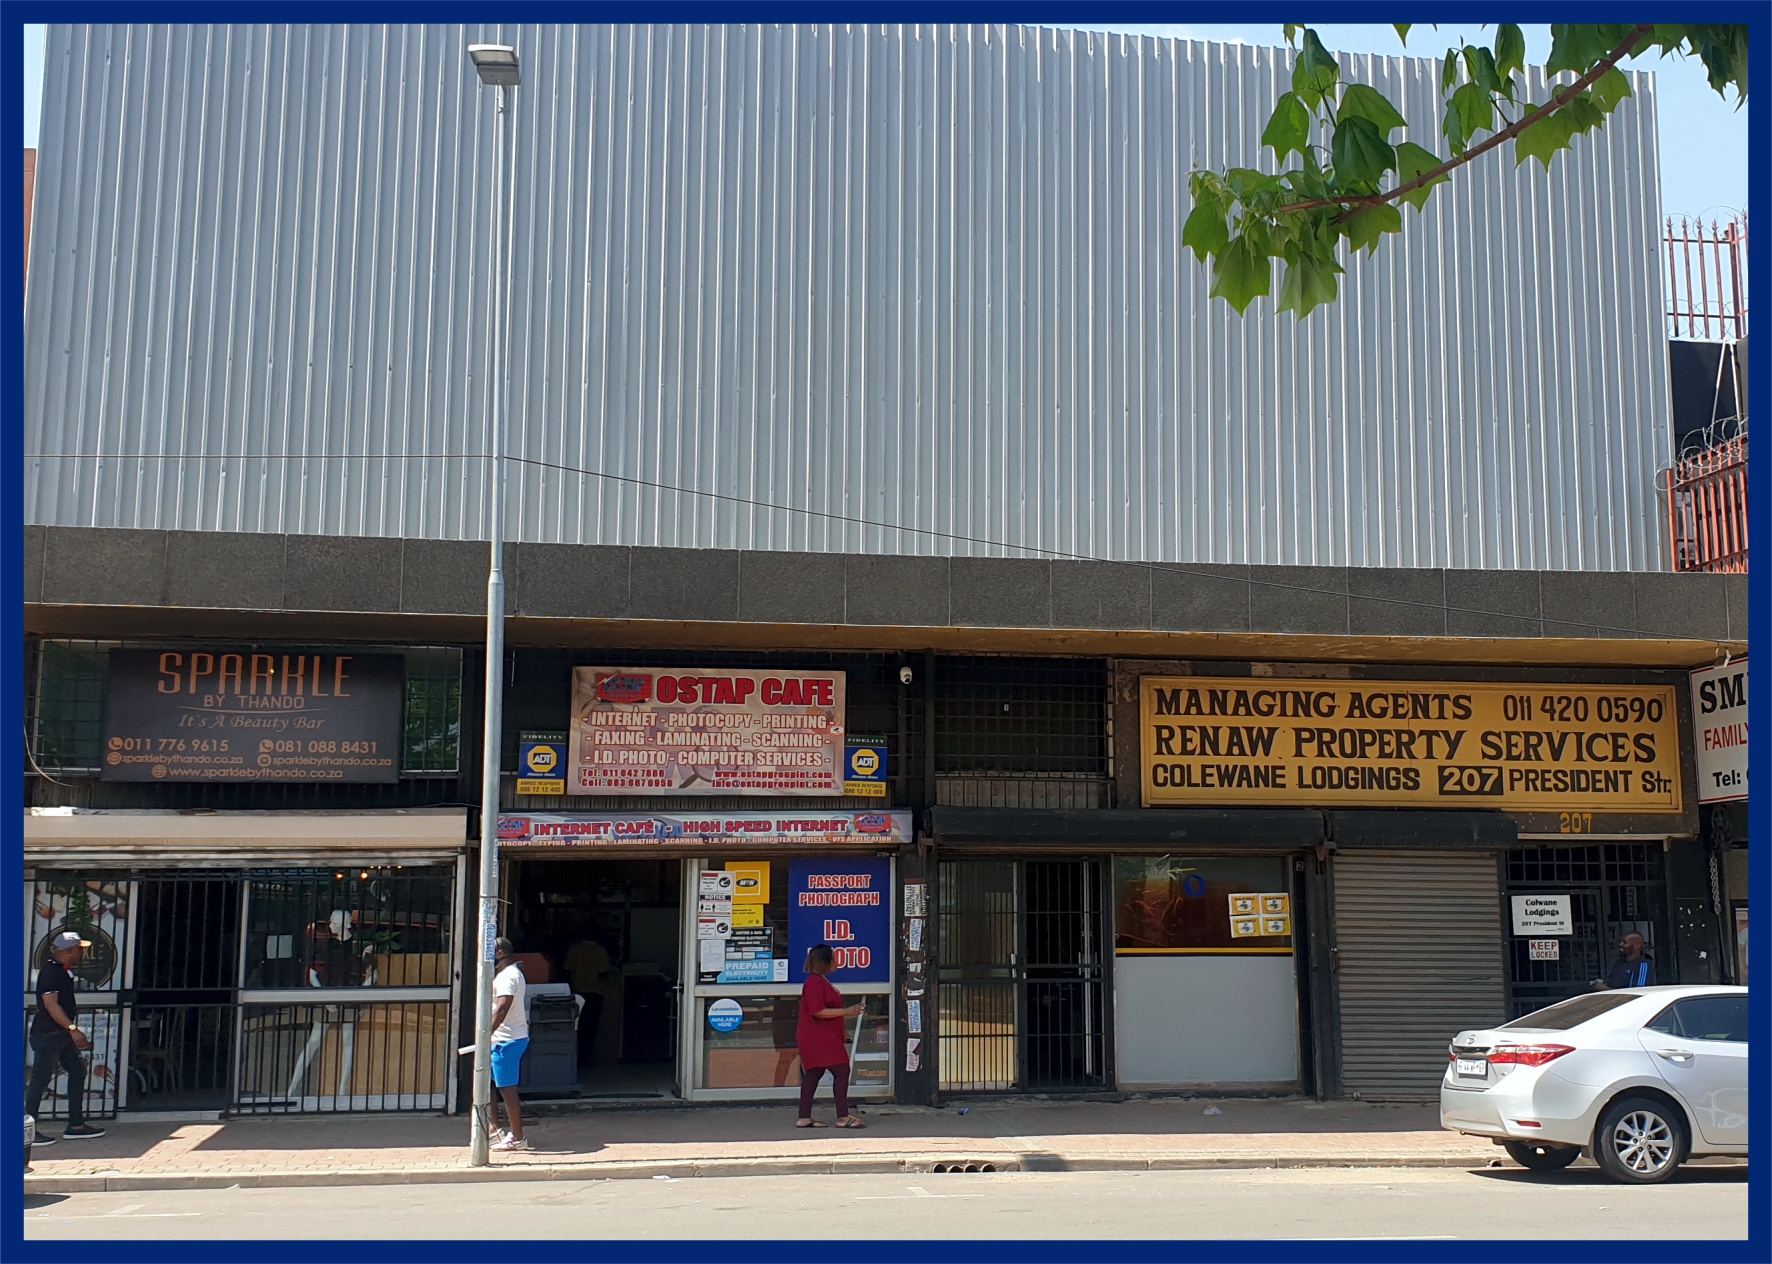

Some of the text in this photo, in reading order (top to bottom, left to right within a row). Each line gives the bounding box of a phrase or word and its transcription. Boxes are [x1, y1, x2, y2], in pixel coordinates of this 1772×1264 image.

[157, 652, 353, 697] SPARKLE
[656, 675, 835, 706] OSTAP CAFE
[203, 694, 305, 709] BY THANDO
[1154, 688, 1663, 723] MANAGING AGENTS 011 420 0590
[230, 715, 290, 733] Beauty
[292, 716, 325, 729] Bar
[591, 711, 658, 727] INTERNET
[668, 713, 753, 729] PHOTOCOPY
[762, 714, 828, 729] PRINTING
[123, 738, 230, 752] 011 776 9615
[275, 740, 378, 754] 081 088 8431
[594, 730, 646, 745] FAXING
[656, 731, 742, 747] LAMINATING
[752, 733, 824, 748] SCANNING
[1153, 725, 1656, 763] RENAW PROPERTY SERVICES
[533, 754, 552, 763] ADT
[594, 750, 617, 764] I.D.
[619, 750, 668, 765] PHOTO
[677, 751, 755, 766] COMPUTER
[756, 752, 823, 767] SERVICES
[857, 757, 875, 767] ADT
[168, 767, 344, 779] www.sparklebythando.co.za
[1152, 763, 1672, 794] COLEWANE LODGINGS 207 PRESIDENT Str.
[1712, 769, 1742, 788] Tel:
[534, 823, 612, 836] INTERNET
[614, 820, 654, 834] CAFÉ
[683, 821, 722, 833] HIGH
[724, 820, 773, 833] SPEED
[776, 820, 849, 832] INTERNET
[1559, 813, 1592, 834] 207
[808, 874, 872, 889] PASSPORT
[798, 891, 880, 907] PHOTOGRAPH
[823, 919, 855, 941] I.D.
[1530, 941, 1557, 950] KEEP
[725, 962, 769, 970] PREPAID
